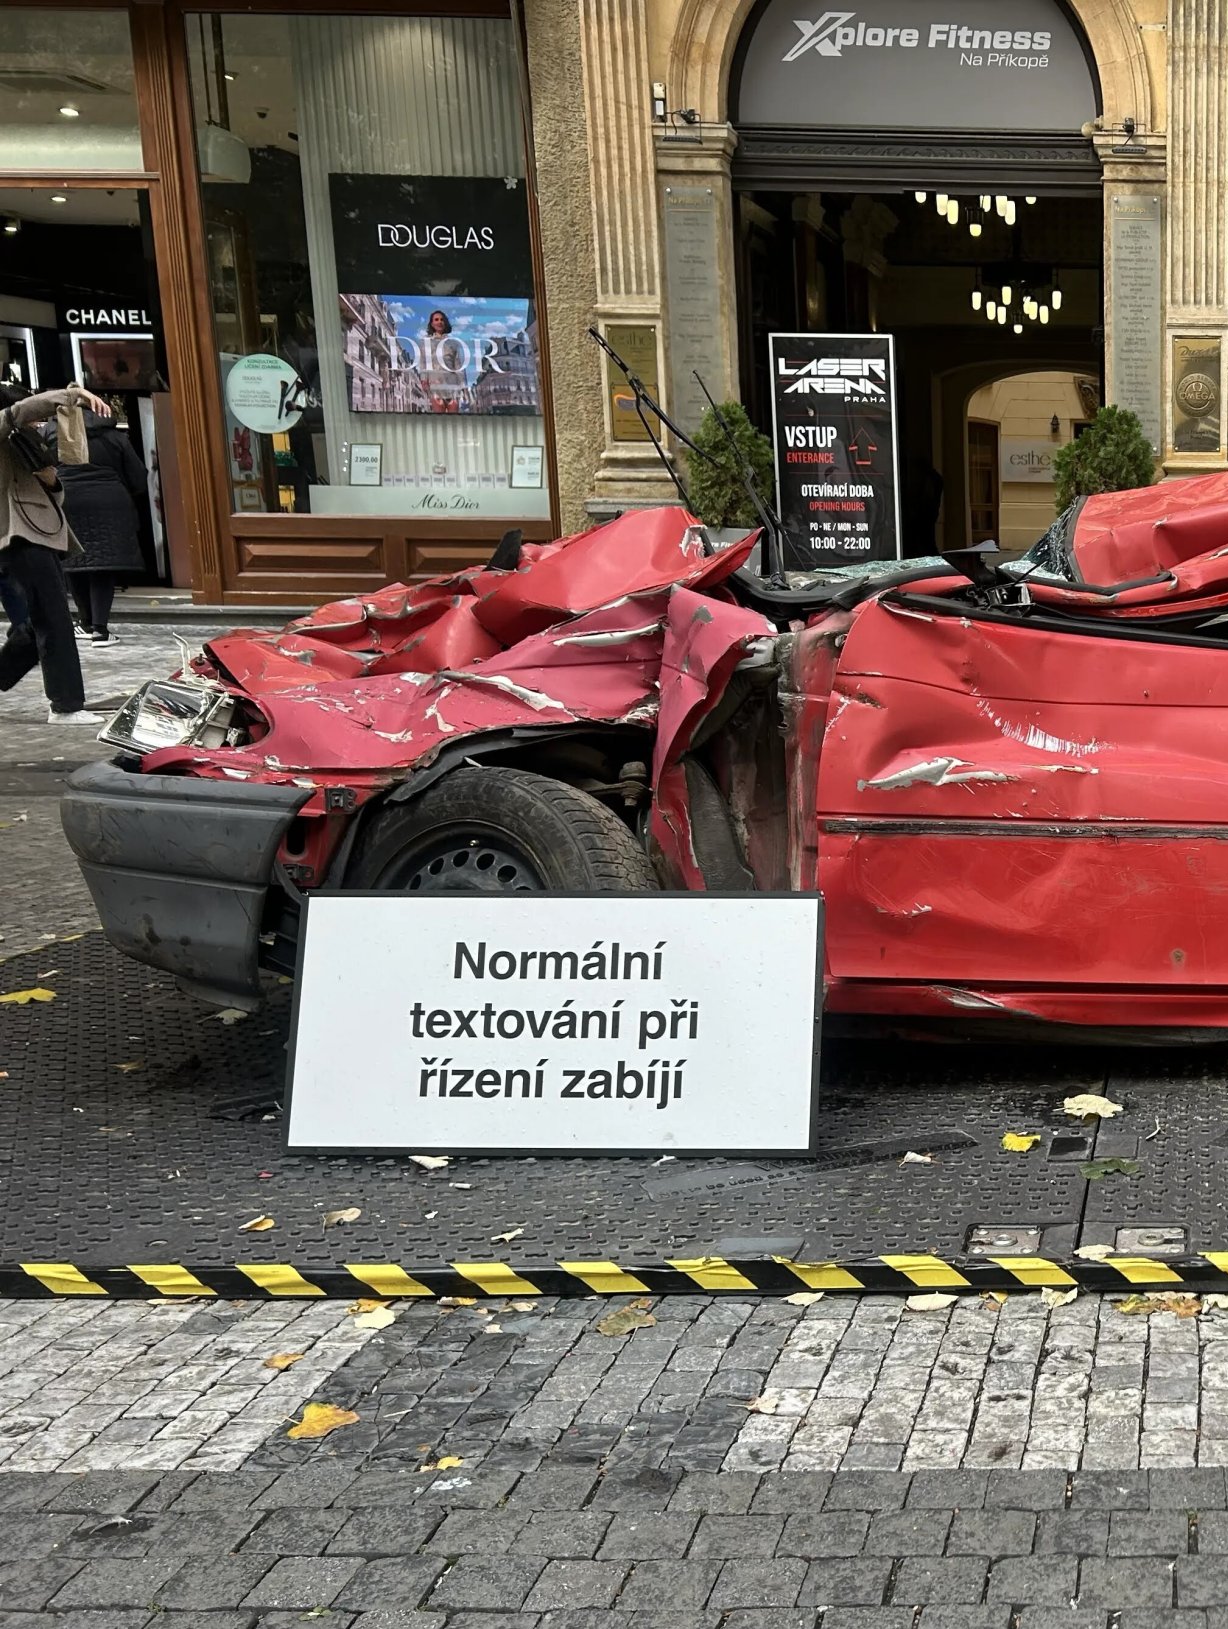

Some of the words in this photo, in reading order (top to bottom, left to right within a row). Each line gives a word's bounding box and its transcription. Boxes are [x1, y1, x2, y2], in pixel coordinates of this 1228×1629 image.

[781, 11, 920, 62] Xplore
[927, 23, 1051, 51] Fitness
[959, 52, 983, 67] Na
[987, 52, 1050, 70] Příkopě
[377, 223, 495, 250] DOUGLAS
[66, 308, 152, 326] CHANEL
[387, 335, 509, 374] DIOR
[778, 357, 886, 381] LASER
[783, 377, 887, 395] ARENA
[1180, 392, 1216, 400] OMEGA
[784, 425, 838, 448] VSTUP
[786, 452, 835, 464] ENTERANCE
[801, 482, 848, 498] OTEVÍRACÍ
[849, 484, 875, 498] DOBA
[411, 493, 449, 510] Miss
[449, 494, 481, 510] Dior
[809, 501, 841, 512] OPENING
[841, 501, 866, 512] HOURS
[809, 522, 819, 531] PO
[823, 522, 832, 531] NE
[837, 522, 852, 531] MON
[856, 522, 869, 532] SUN
[809, 536, 836, 550] 10:00
[843, 537, 871, 550] 22:00
[453, 940, 669, 981] Normální
[409, 999, 623, 1040] textování
[638, 999, 699, 1050] při
[419, 1056, 550, 1100] řízení
[560, 1058, 687, 1110] zabíjí
